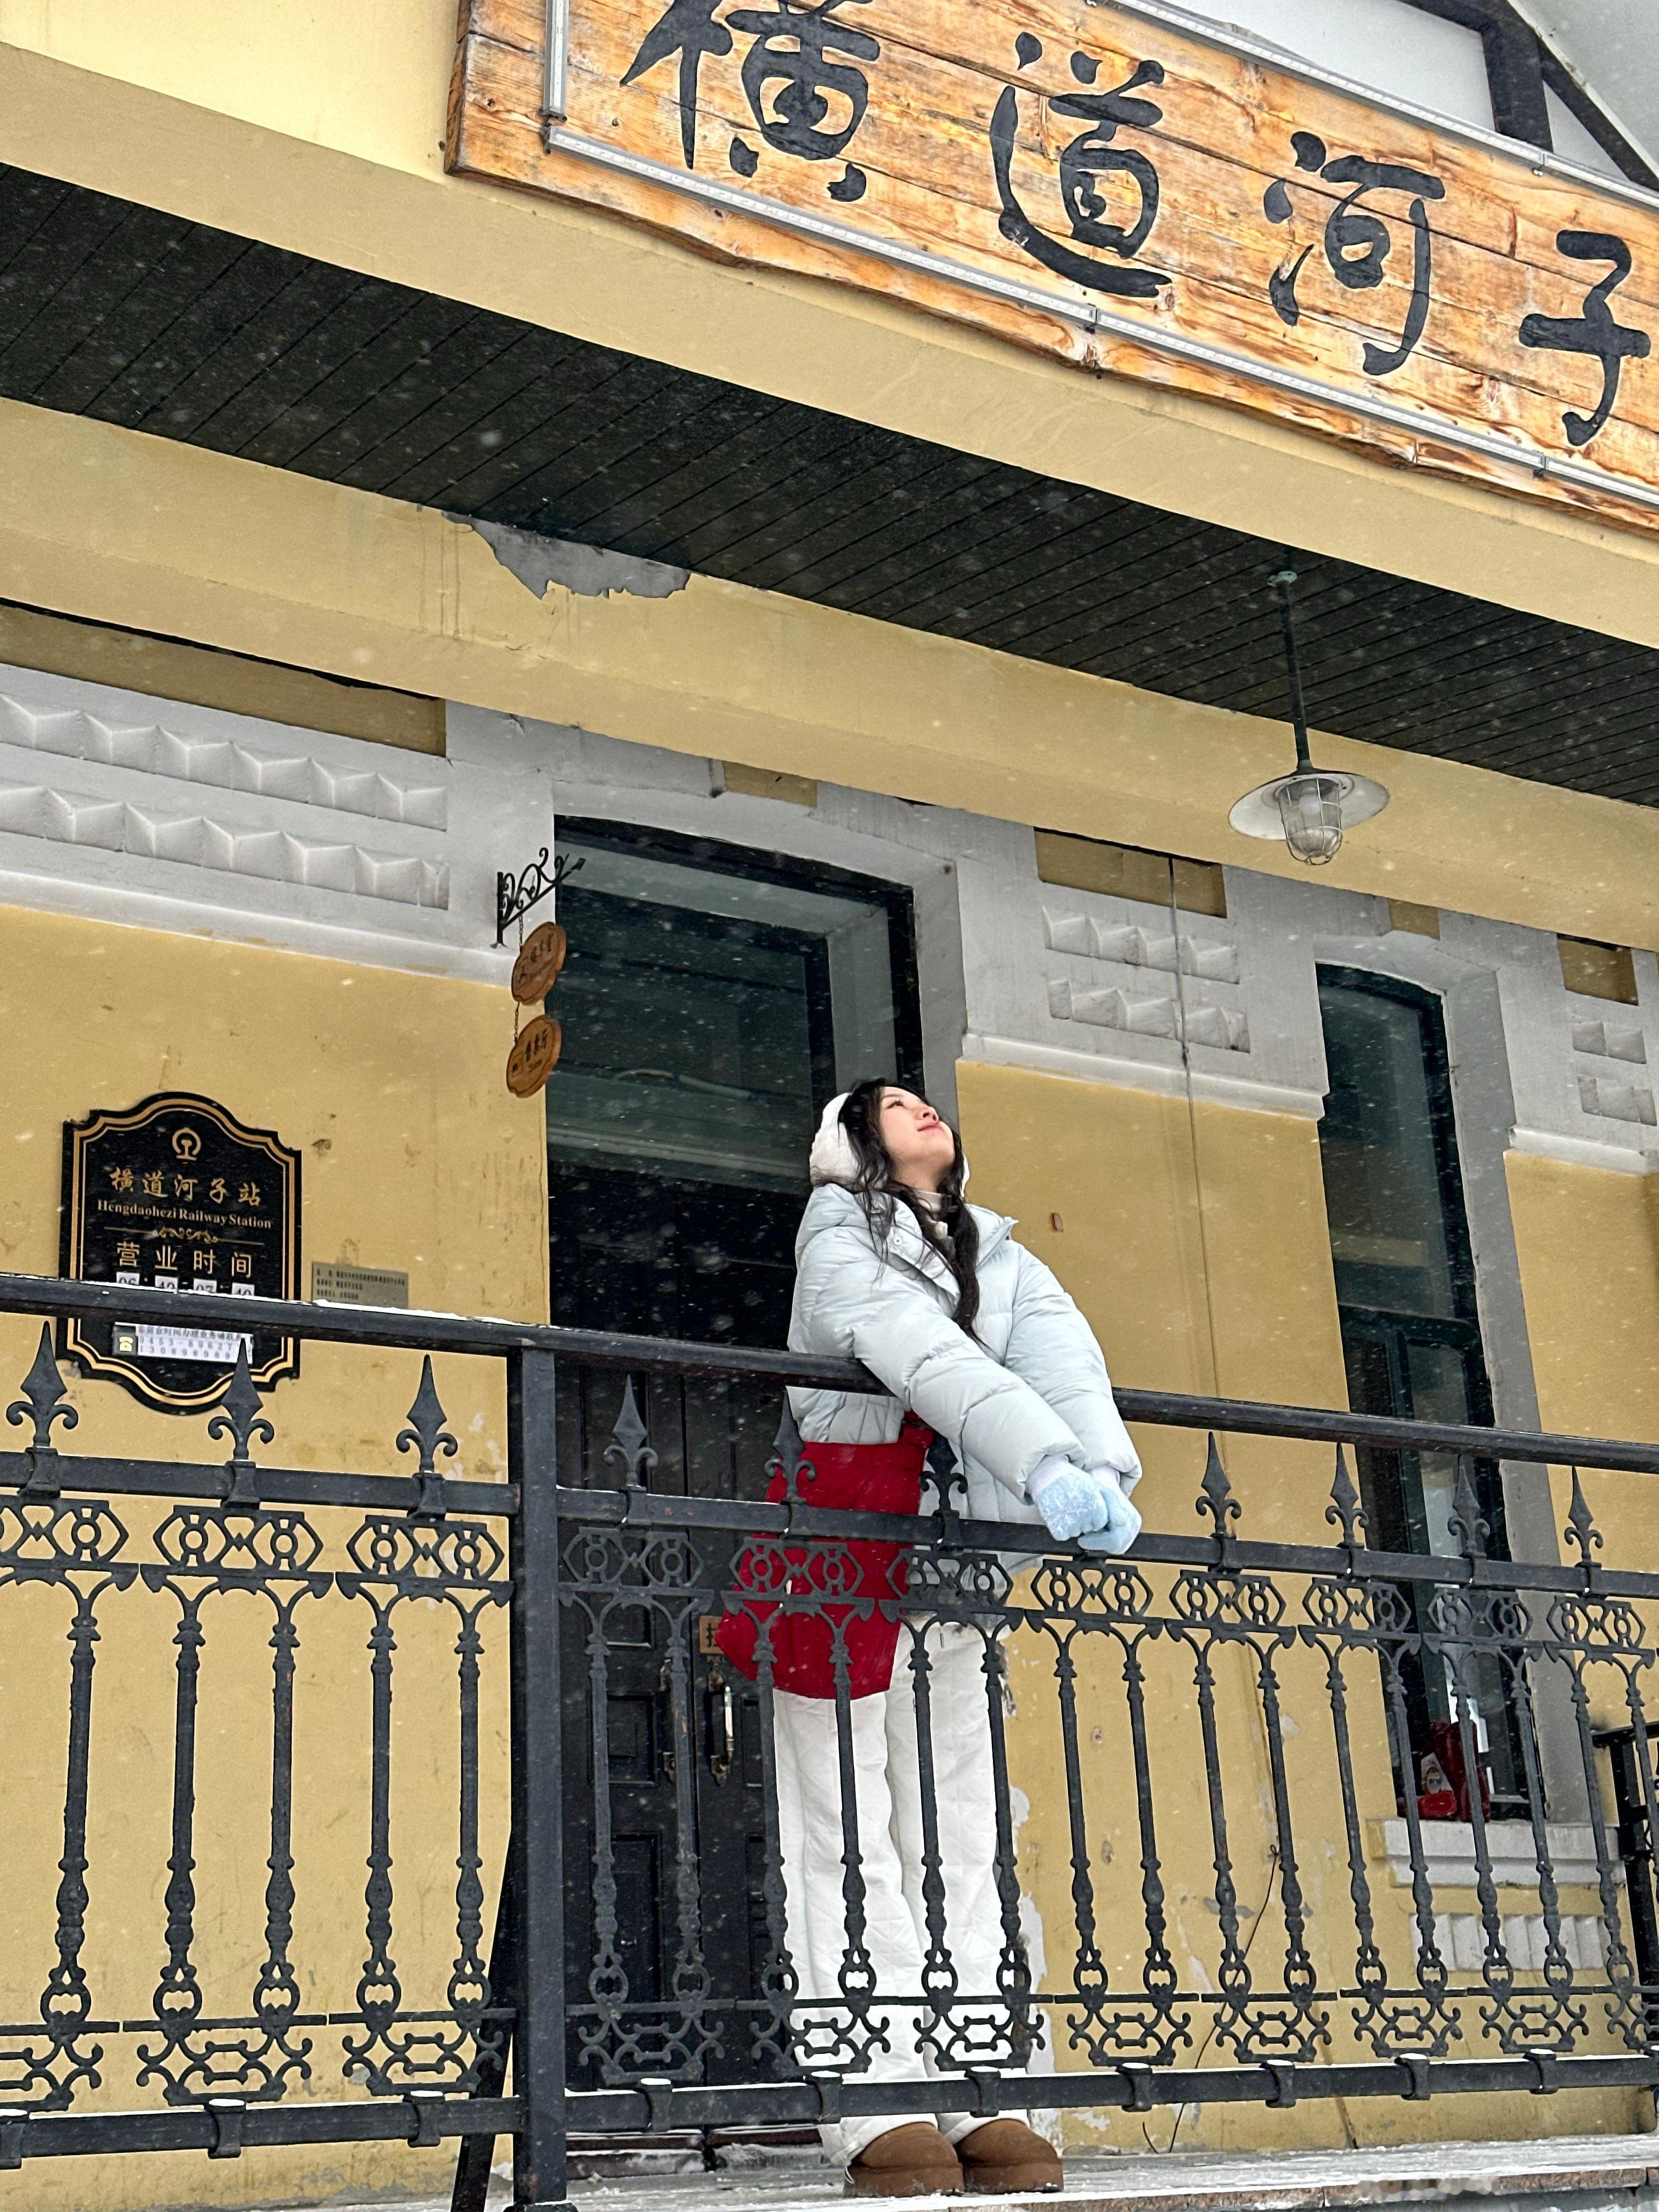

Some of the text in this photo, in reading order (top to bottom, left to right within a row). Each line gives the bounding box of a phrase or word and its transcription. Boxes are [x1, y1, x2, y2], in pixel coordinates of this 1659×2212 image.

[620, 0, 1650, 447] 横道河子
[110, 1166, 261, 1206] 横道河子站
[97, 1198, 272, 1229] Hengdaohezi Railway Station
[117, 1241, 252, 1278] 营业时间
